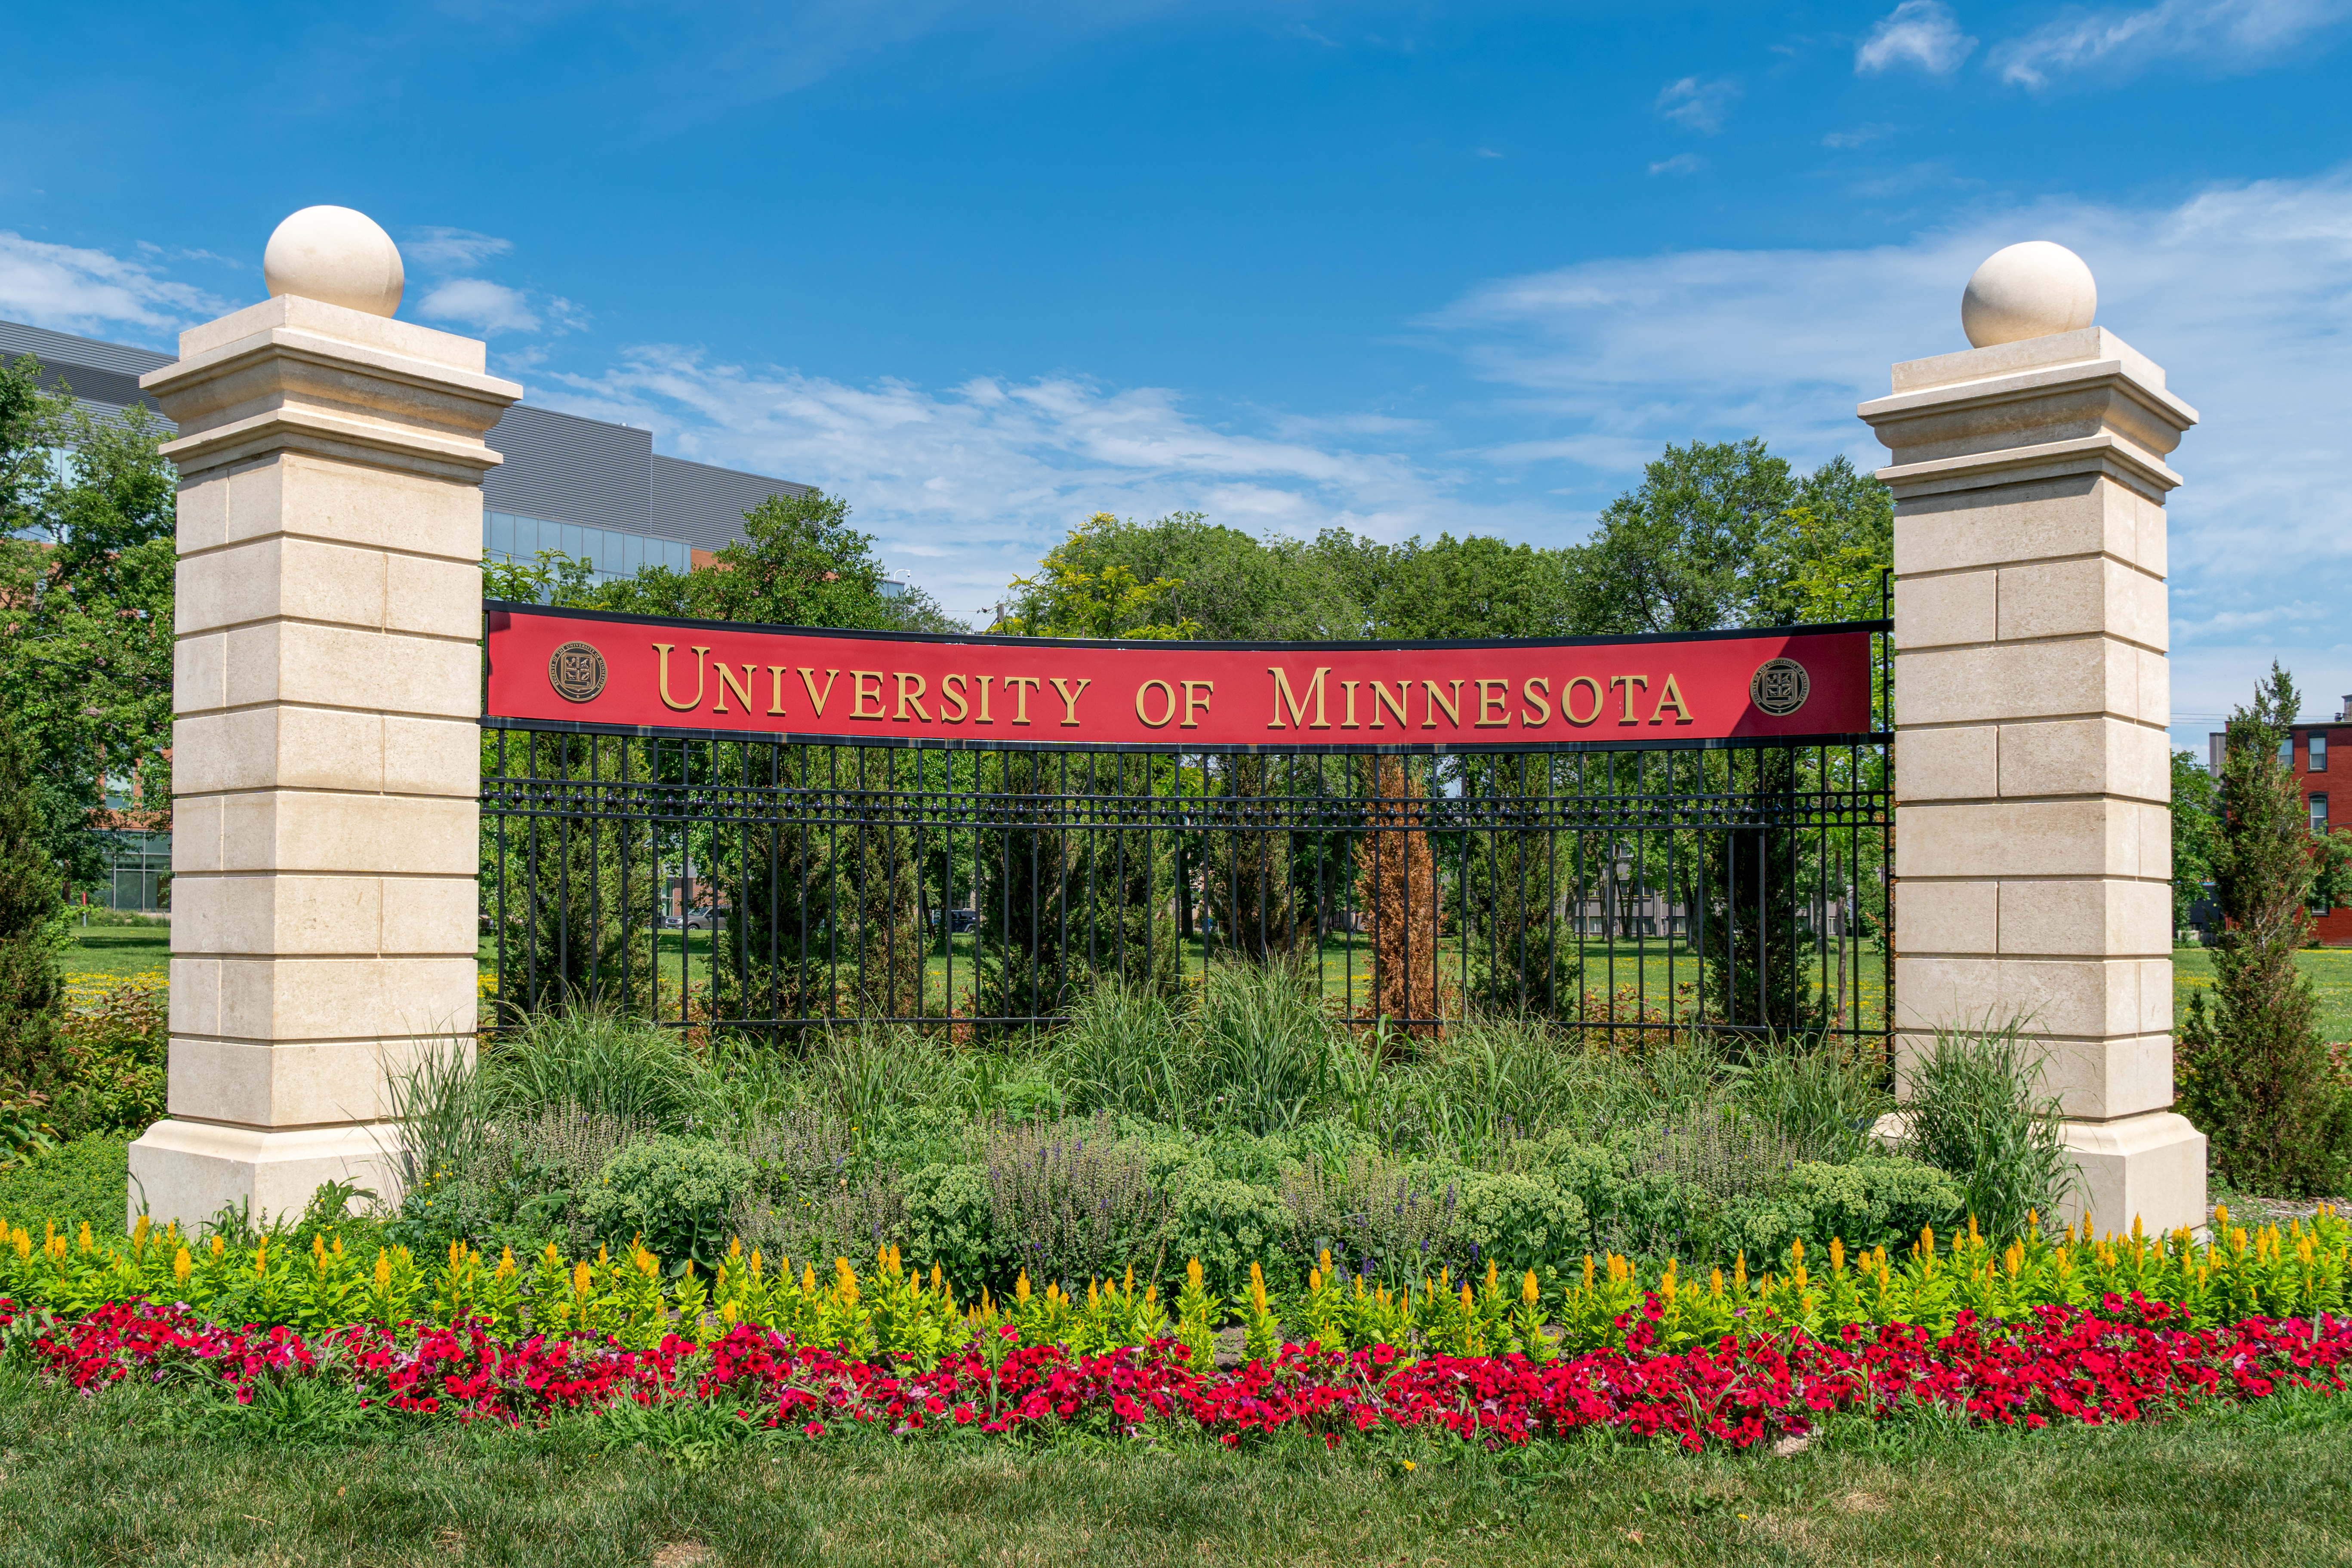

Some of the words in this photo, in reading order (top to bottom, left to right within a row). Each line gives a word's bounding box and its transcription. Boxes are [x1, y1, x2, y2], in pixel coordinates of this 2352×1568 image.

[566, 644, 595, 653] UNIVERSITY
[652, 643, 1092, 724] UNIVERSITY
[1135, 679, 1214, 726] OF
[1267, 667, 1694, 727] MINNESOTA
